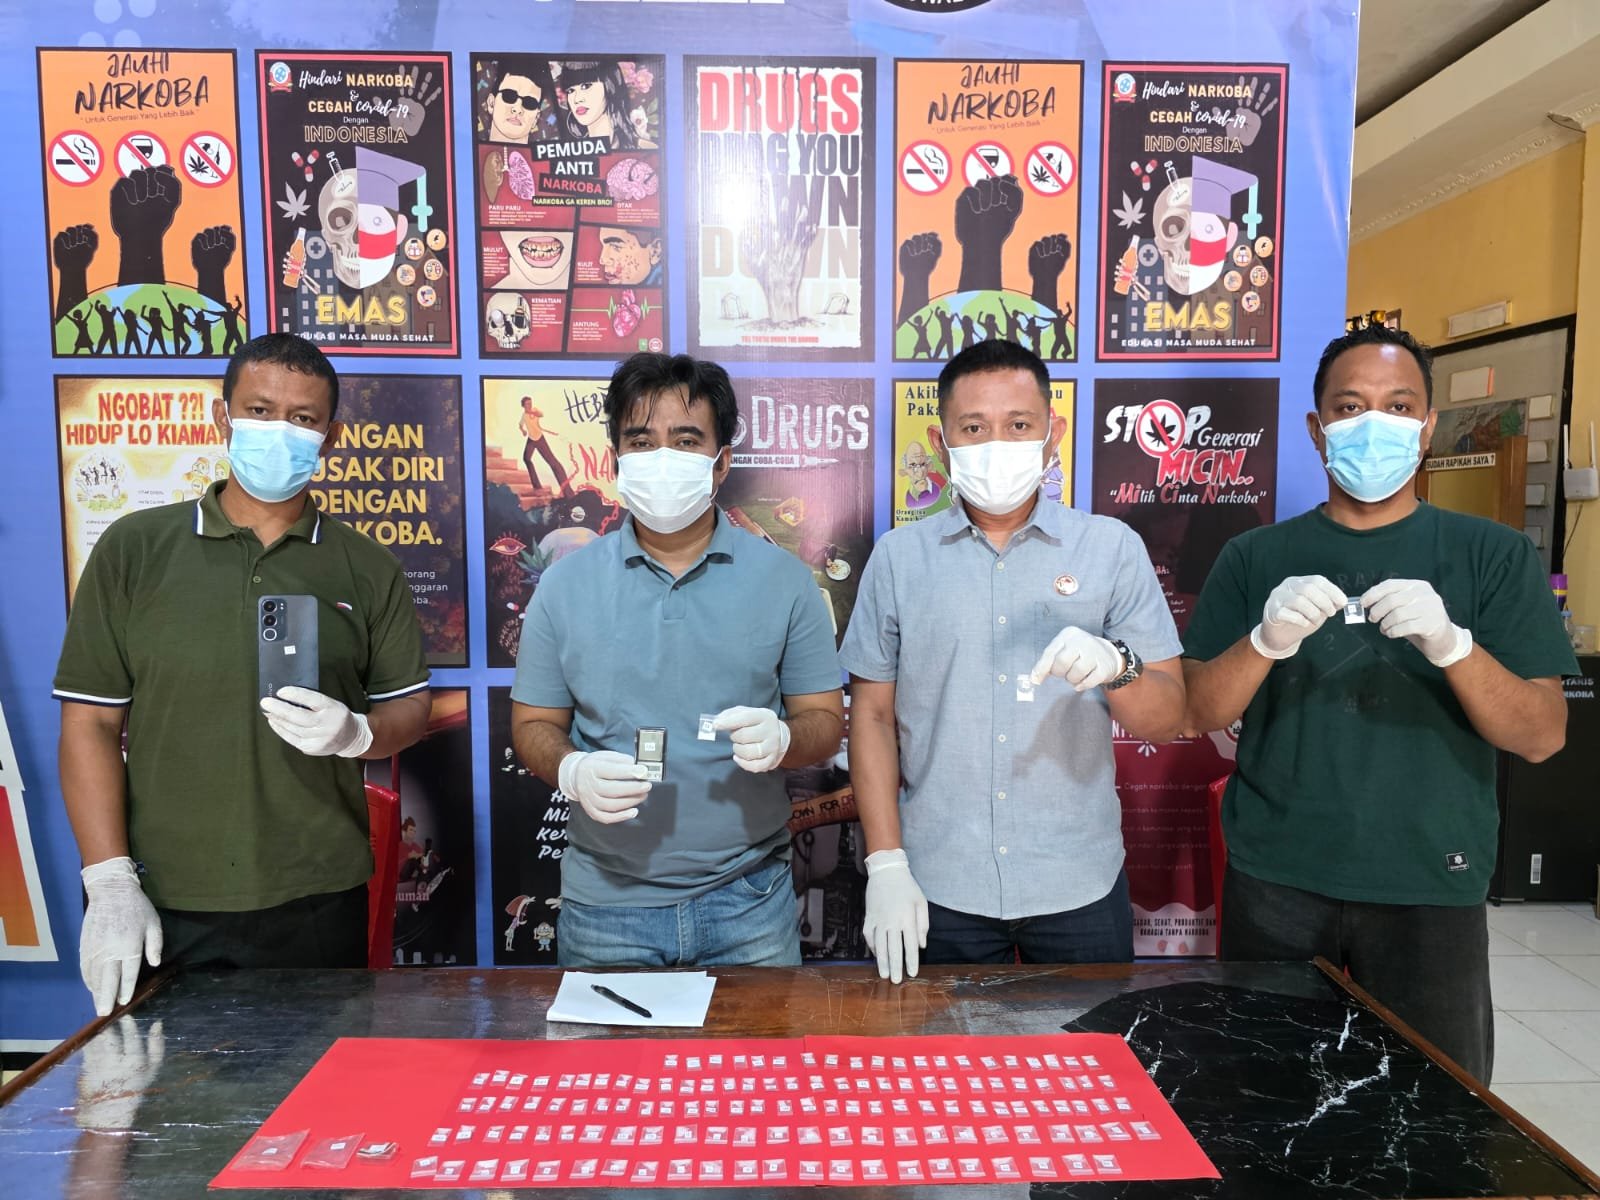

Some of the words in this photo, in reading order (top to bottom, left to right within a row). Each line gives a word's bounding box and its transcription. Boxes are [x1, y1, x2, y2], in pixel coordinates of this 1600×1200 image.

[107, 52, 169, 78] JAUHI
[960, 62, 1020, 88] JAUHI
[299, 69, 343, 89] Hindari
[346, 73, 414, 88] NARKOBA
[75, 75, 209, 114] NARKOBA
[349, 90, 360, 102] &
[1142, 80, 1185, 100] Hindari
[1188, 84, 1252, 98] NARKOBA
[308, 100, 353, 113] CEGAH
[700, 71, 860, 135] DRUGS
[928, 86, 1056, 124] NARKOBA
[1190, 101, 1200, 112] &
[140, 112, 158, 120] Yang
[343, 116, 369, 125] Dengan
[1150, 110, 1193, 123] CEGAH
[304, 125, 409, 143] INDONESIA
[1182, 126, 1208, 135] Dengan
[536, 139, 607, 159] PEMUDA
[1144, 135, 1243, 153] INDONESIA
[796, 133, 860, 176] YOU
[555, 161, 594, 176] ANTI
[543, 177, 602, 194] NARKOBA
[316, 293, 408, 326] EMAS
[1144, 300, 1233, 331] EMAS
[339, 333, 367, 341] MASA
[371, 333, 399, 341] MUDA
[402, 333, 434, 342] SEHAT
[1121, 338, 1163, 347] EDUKASI
[1225, 339, 1257, 347] SEHAT
[98, 392, 174, 422] NGOBAT
[752, 395, 869, 450] DRUGS
[1104, 400, 1211, 458] STOP
[1198, 427, 1264, 447] Generasi
[66, 424, 123, 446] HIDUP
[128, 424, 151, 445] LO
[334, 423, 424, 449] NGAN
[310, 456, 386, 482] USAK
[392, 456, 444, 482] DIRI
[1473, 455, 1489, 465] SAYA
[310, 488, 427, 514] DENGAN
[1161, 483, 1199, 504] Cinta
[404, 571, 436, 579] orang
[396, 892, 430, 901] uman
